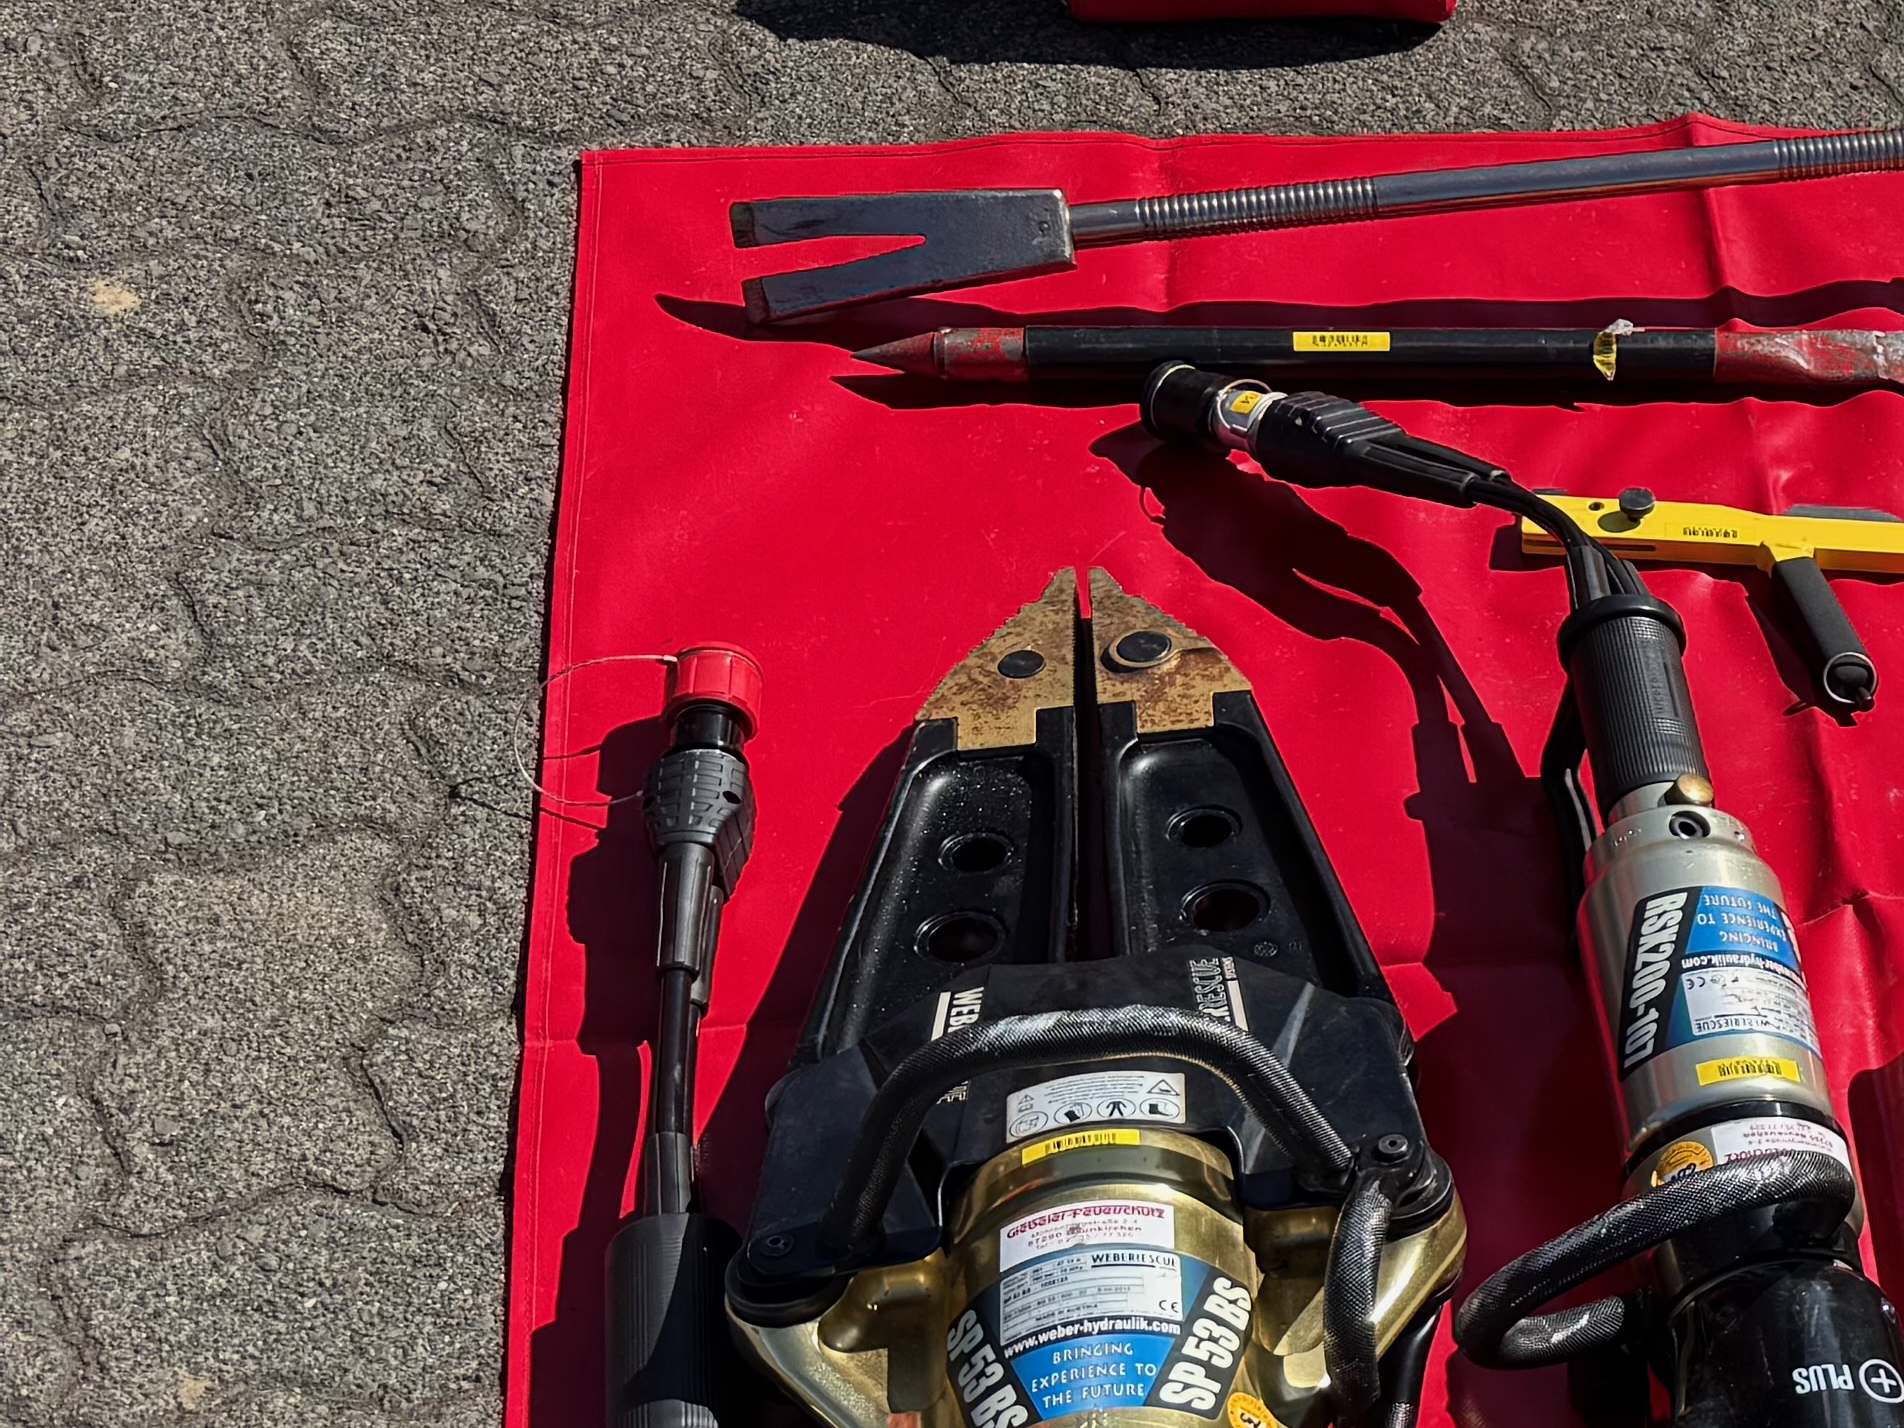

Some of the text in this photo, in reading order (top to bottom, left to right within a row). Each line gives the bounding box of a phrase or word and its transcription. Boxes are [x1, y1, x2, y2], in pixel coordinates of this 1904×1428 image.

[1703, 894, 1753, 910] FUTURE
[1696, 912, 1787, 942] EXPERIENCE TO
[1719, 930, 1779, 953] BRINGING
[1623, 891, 1689, 1069] RSK200-107
[1091, 1252, 1177, 1268] WEBERRESCUE
[947, 1309, 984, 1361] SP
[1003, 1316, 1182, 1359] www.weber-hydraulik.com
[1159, 1275, 1252, 1411] SP 53 BS
[1052, 1342, 1134, 1365] BRINGING
[958, 1342, 1005, 1404] 53
[1031, 1363, 1157, 1393] EXPERIENCE TO
[1792, 1364, 1854, 1395] PLUS
[1042, 1383, 1145, 1409] THE FUTURE
